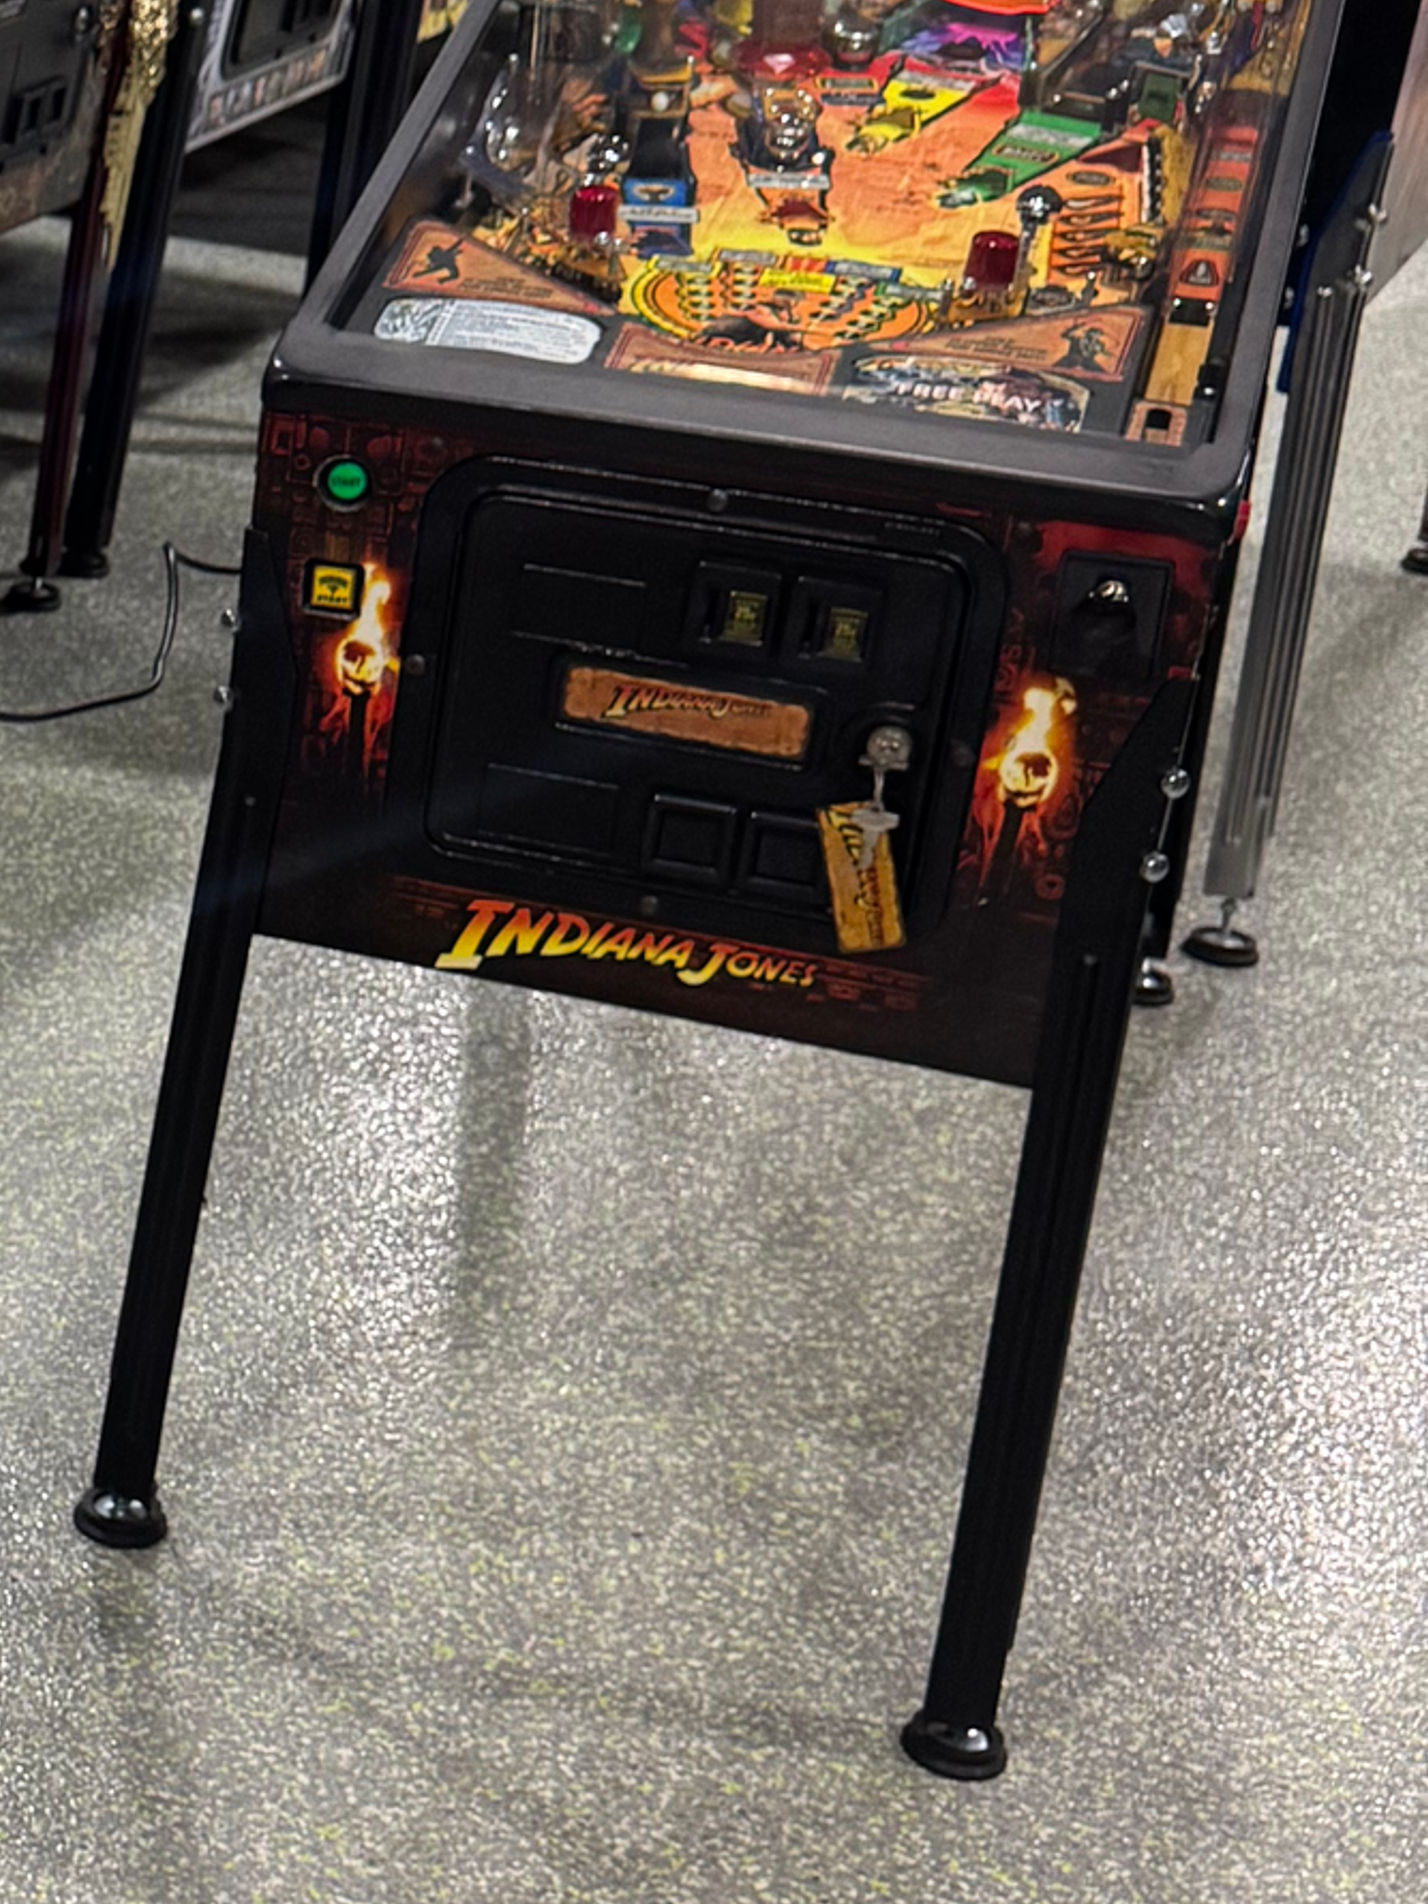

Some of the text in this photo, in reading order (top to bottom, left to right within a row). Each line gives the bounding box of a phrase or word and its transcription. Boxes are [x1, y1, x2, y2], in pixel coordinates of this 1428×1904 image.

[896, 382, 964, 401] FREE
[602, 684, 716, 720] INDIANA
[434, 899, 819, 988] INDIANA JONES
